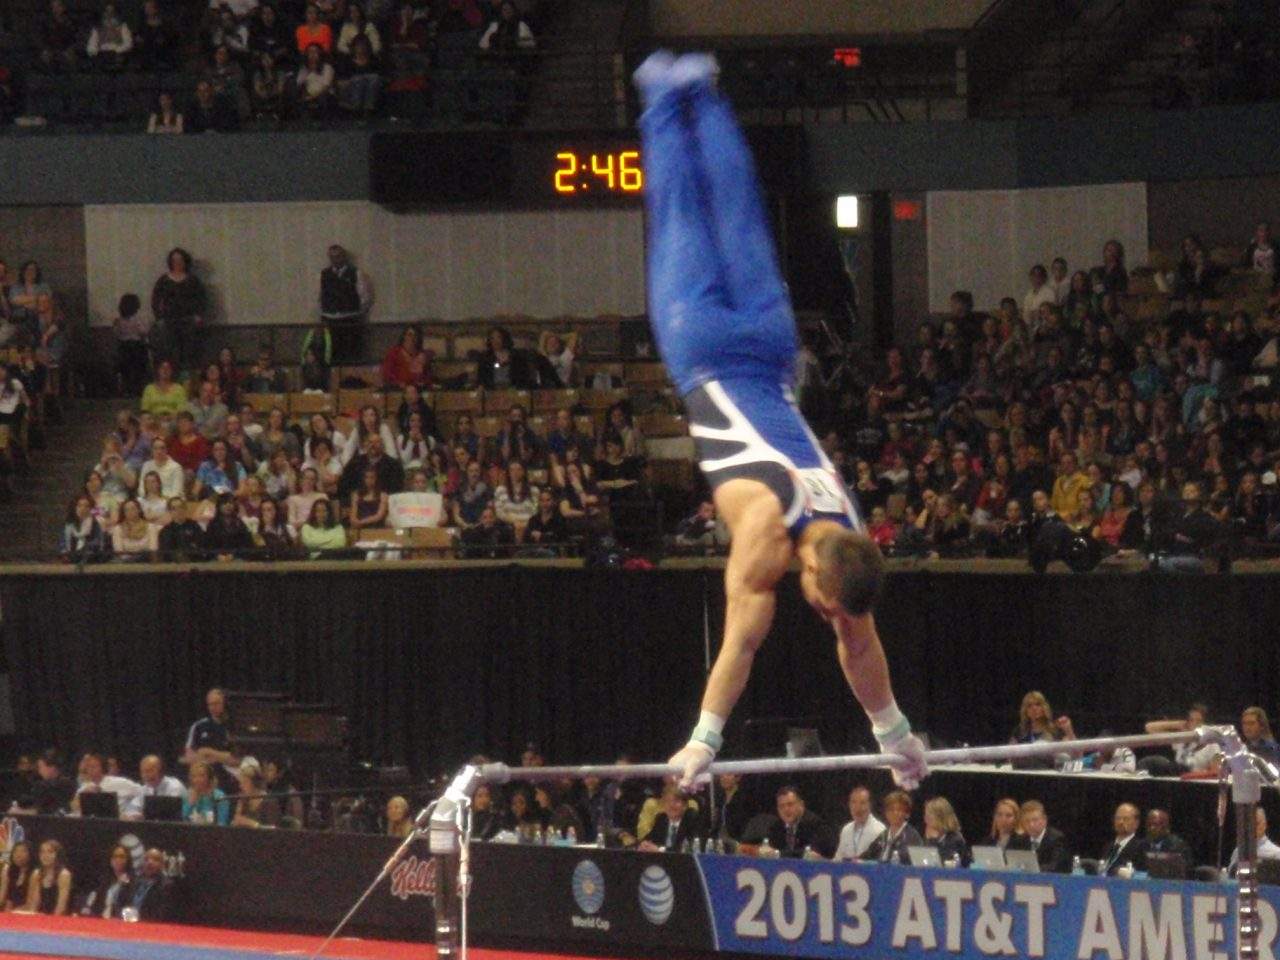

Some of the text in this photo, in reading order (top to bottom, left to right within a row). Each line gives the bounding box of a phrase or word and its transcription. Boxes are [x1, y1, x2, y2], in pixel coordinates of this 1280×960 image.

[555, 151, 642, 192] 2:46
[734, 869, 872, 945] 2013
[891, 877, 1056, 959] AT&T
